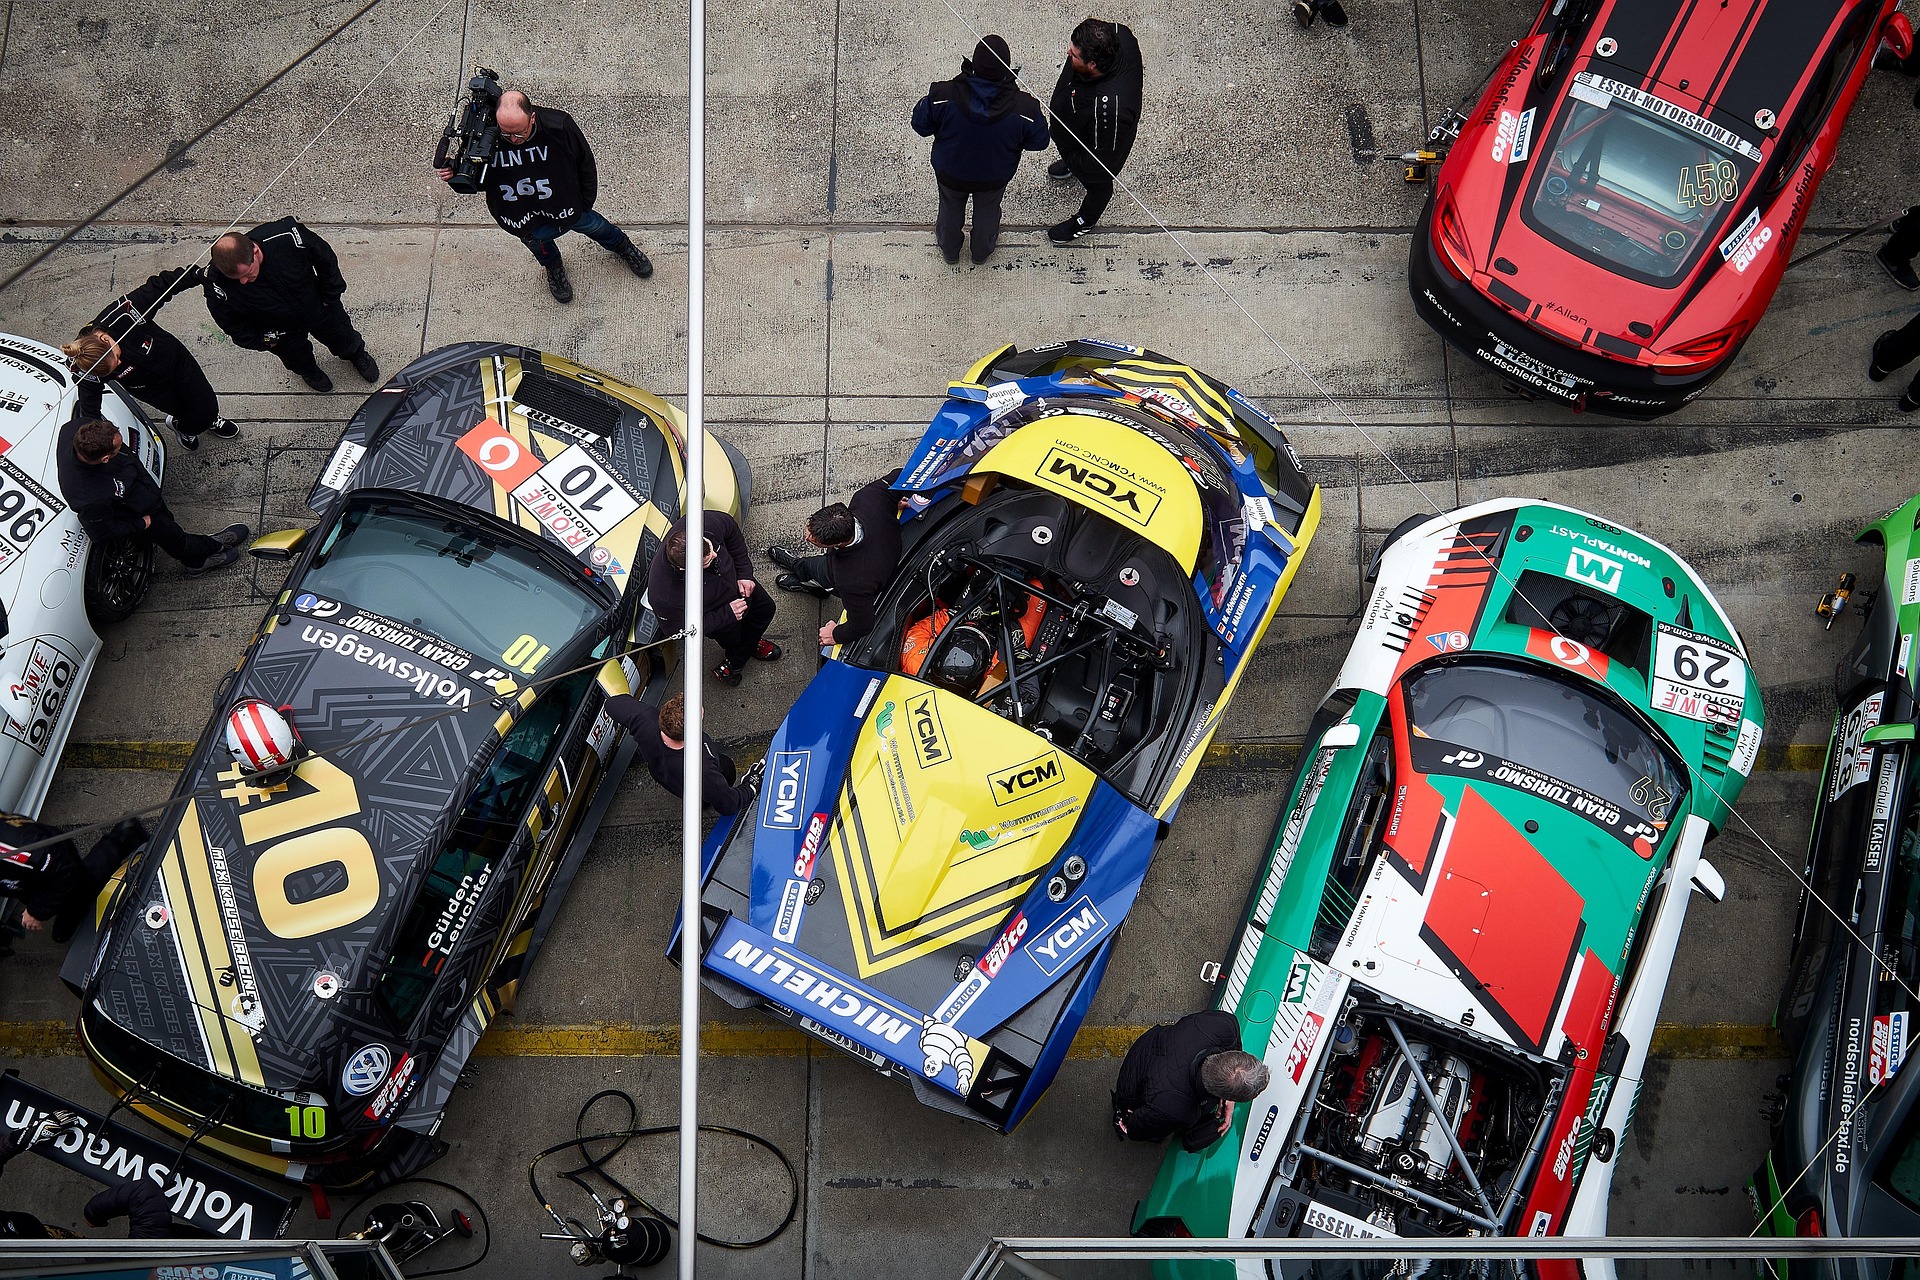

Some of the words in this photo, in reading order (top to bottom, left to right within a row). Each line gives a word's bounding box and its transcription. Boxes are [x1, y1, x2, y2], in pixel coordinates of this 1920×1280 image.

[1507, 116, 1518, 144] sport
[1516, 116, 1529, 153] BASTUCK
[1598, 76, 1743, 151] ESSEN-MOTORSHOW.DE
[525, 145, 548, 162] TV
[1491, 110, 1512, 162] auto
[499, 177, 553, 202] 265
[1677, 159, 1739, 208] 458
[1726, 220, 1754, 252] BASTUCK
[1732, 239, 1752, 264] sport
[1735, 226, 1773, 273] auto
[1545, 301, 1588, 326] #Allan
[1487, 331, 1519, 354] Porsche
[1520, 351, 1556, 373] Zentrum
[987, 387, 1020, 399] solution
[1476, 347, 1579, 402] nordschleife-taxi.d
[329, 444, 355, 485] solutions
[578, 439, 647, 504] www.rowe.com.de
[1050, 457, 1146, 514] YCM
[1056, 439, 1167, 495] www.YCMCNC.com
[0, 475, 45, 543] 96
[541, 484, 557, 502] OIL
[560, 465, 613, 513] 10
[523, 488, 588, 549] ROWE
[556, 503, 594, 538] MOTOR
[66, 527, 87, 569] solution
[1549, 524, 1652, 569] MONTAPLAST
[357, 609, 402, 630] SIMULATOR
[1366, 586, 1387, 630] solutions
[345, 615, 421, 652] TURISMO
[403, 625, 435, 643] DRIVING
[436, 639, 456, 652] REAL
[456, 648, 473, 660] THE
[501, 633, 552, 675] 10
[301, 624, 473, 713] Volkswagen
[419, 643, 470, 671] GRAN
[1674, 644, 1731, 689] 29
[30, 660, 70, 744] 960
[1661, 692, 1741, 724] ROWE
[1668, 684, 1689, 696] OIL
[1693, 689, 1743, 708] MOTOR
[914, 698, 942, 761] YCM
[1740, 726, 1761, 773] solutions
[1501, 759, 1548, 781] SIMULATOR
[1839, 710, 1863, 793] 678
[773, 757, 802, 824] YCM
[997, 760, 1058, 795] YCM
[1494, 765, 1572, 806] TURISMO
[1549, 775, 1582, 795] DRIVING
[1583, 789, 1605, 806] REAL
[1628, 775, 1673, 822] 29
[1875, 755, 1898, 815] fahrschule
[1572, 796, 1621, 826] GRAN
[1605, 799, 1621, 813] THE
[794, 816, 821, 878] auto
[811, 821, 824, 855] sport
[210, 847, 232, 884] MAX
[1374, 860, 1386, 881] RAST
[1640, 866, 1657, 904] VANTHOOR
[220, 884, 245, 942] KRUSE
[427, 874, 475, 950] Gülden
[440, 863, 493, 956] Leuchter
[780, 888, 799, 931] BASTUCK
[1346, 905, 1371, 948] VANTHOOR
[985, 933, 1008, 963] sport
[988, 917, 1029, 975] auto
[1034, 907, 1098, 960] YCM
[1625, 927, 1635, 950] RAST
[232, 941, 258, 1003] RACING
[723, 939, 913, 1045] MICHELIN
[945, 981, 979, 1021] BASTUCK
[1285, 1014, 1314, 1079] auto
[1302, 1022, 1319, 1059] sport
[1869, 1019, 1884, 1086] auto
[1879, 1023, 1889, 1059] sport
[1890, 1021, 1901, 1072] BASTUCK
[384, 1079, 417, 1119] BASUCK
[1834, 1018, 1862, 1174] nordschleife-taxi.de
[285, 1105, 327, 1139] 10
[1252, 1111, 1275, 1157] BASTUCK
[1553, 1139, 1567, 1176] sport
[1555, 1115, 1582, 1181] auto
